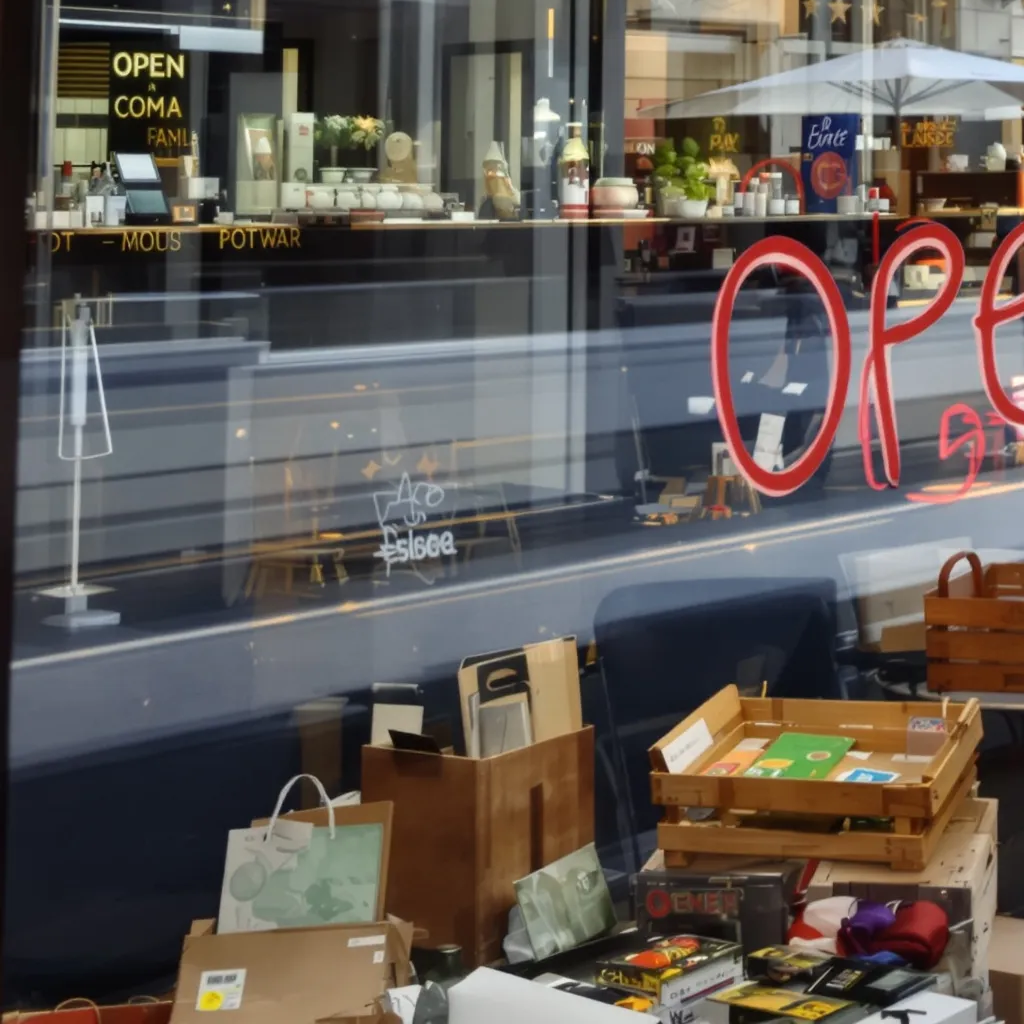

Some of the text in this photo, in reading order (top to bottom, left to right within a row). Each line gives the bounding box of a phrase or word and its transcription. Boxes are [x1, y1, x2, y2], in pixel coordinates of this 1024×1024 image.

[112, 51, 185, 79] OPEN
[114, 95, 183, 119] COMA
[121, 230, 182, 253] MOUS
[219, 227, 301, 250] POTWAR
